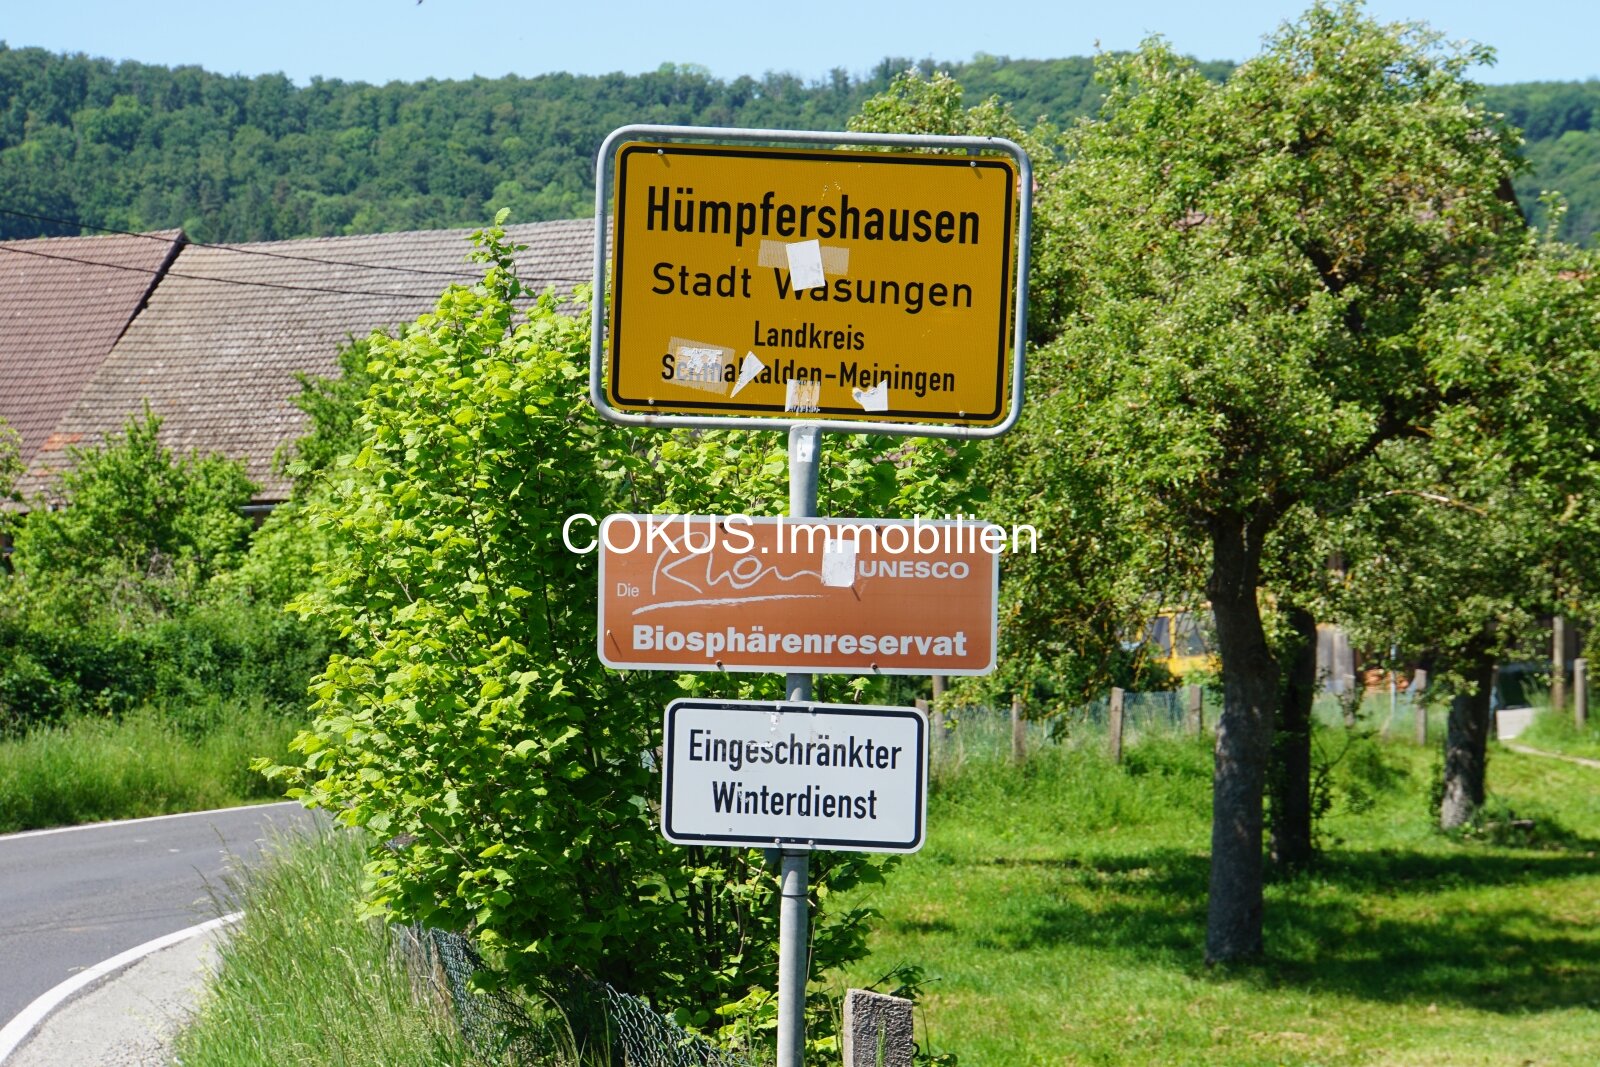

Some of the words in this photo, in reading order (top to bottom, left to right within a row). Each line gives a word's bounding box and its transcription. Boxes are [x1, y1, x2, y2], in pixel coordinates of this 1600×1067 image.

[646, 185, 980, 248] Hümpfershausen
[652, 261, 752, 299] Stadt
[774, 267, 972, 315] Wasungen
[754, 320, 865, 351] Landkreis
[858, 560, 970, 580] UNESCO
[616, 582, 641, 598] Die
[632, 624, 967, 659] Biosphärenreservat
[689, 728, 902, 772] Eingeschränkter
[712, 780, 877, 820] Winterdienst
